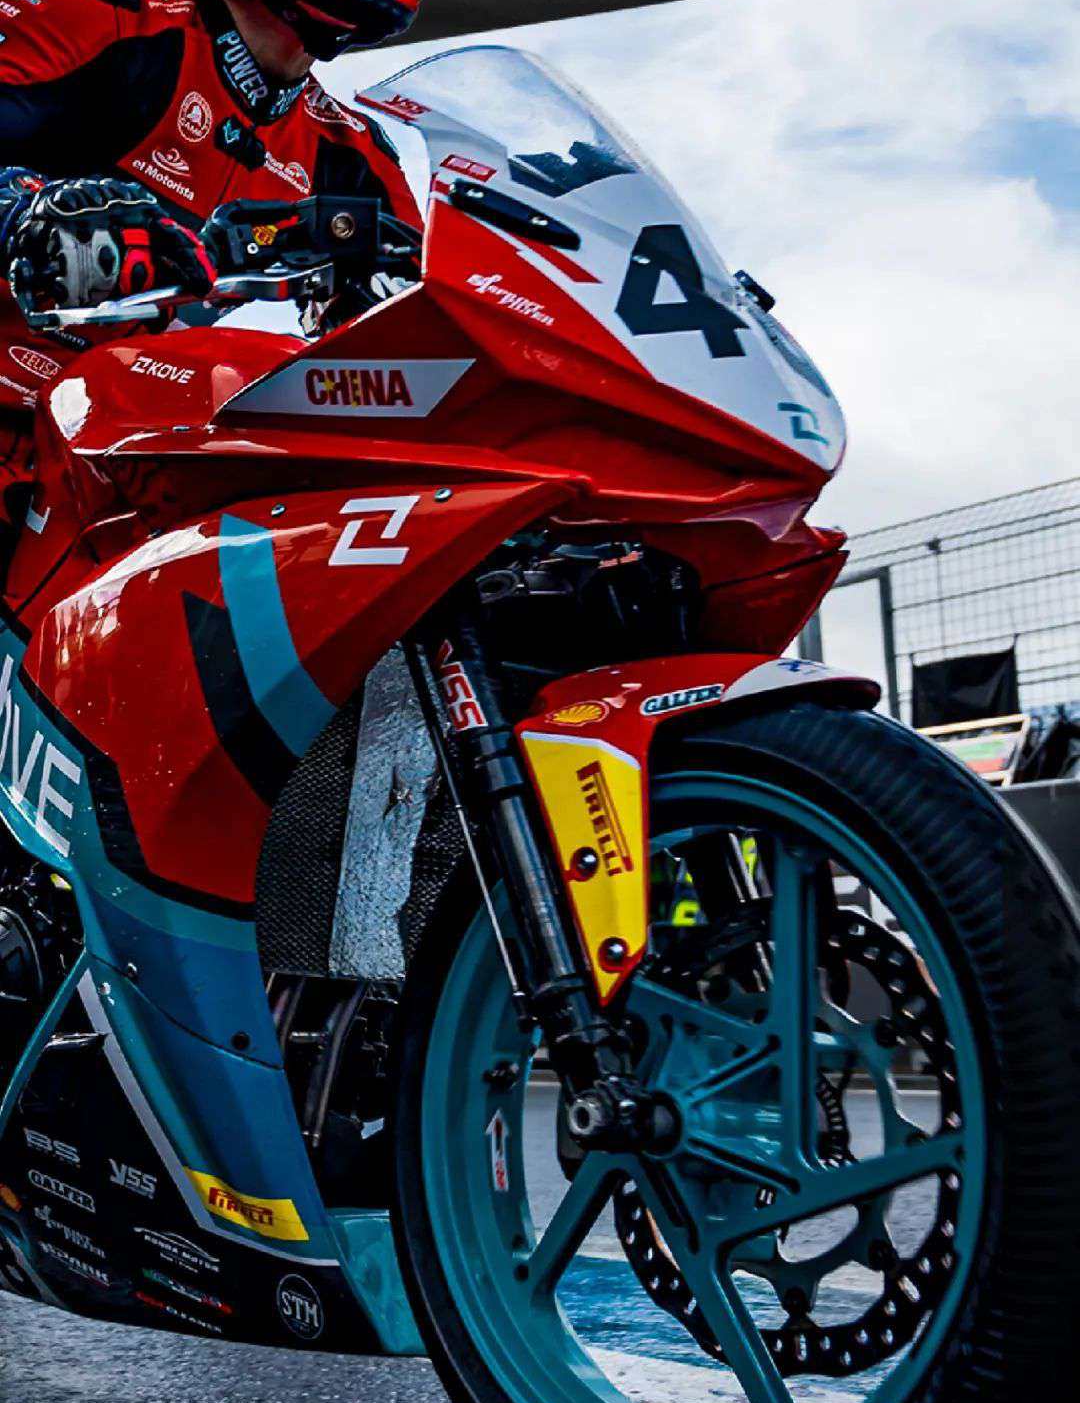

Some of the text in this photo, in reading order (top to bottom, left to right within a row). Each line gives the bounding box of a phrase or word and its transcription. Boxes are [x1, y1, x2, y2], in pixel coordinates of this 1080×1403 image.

[217, 30, 269, 107] POWER
[149, 359, 196, 384] KOVE
[305, 367, 414, 409] CHINA
[576, 760, 634, 877] PIRELLI
[208, 1187, 274, 1226] PIRELLI
